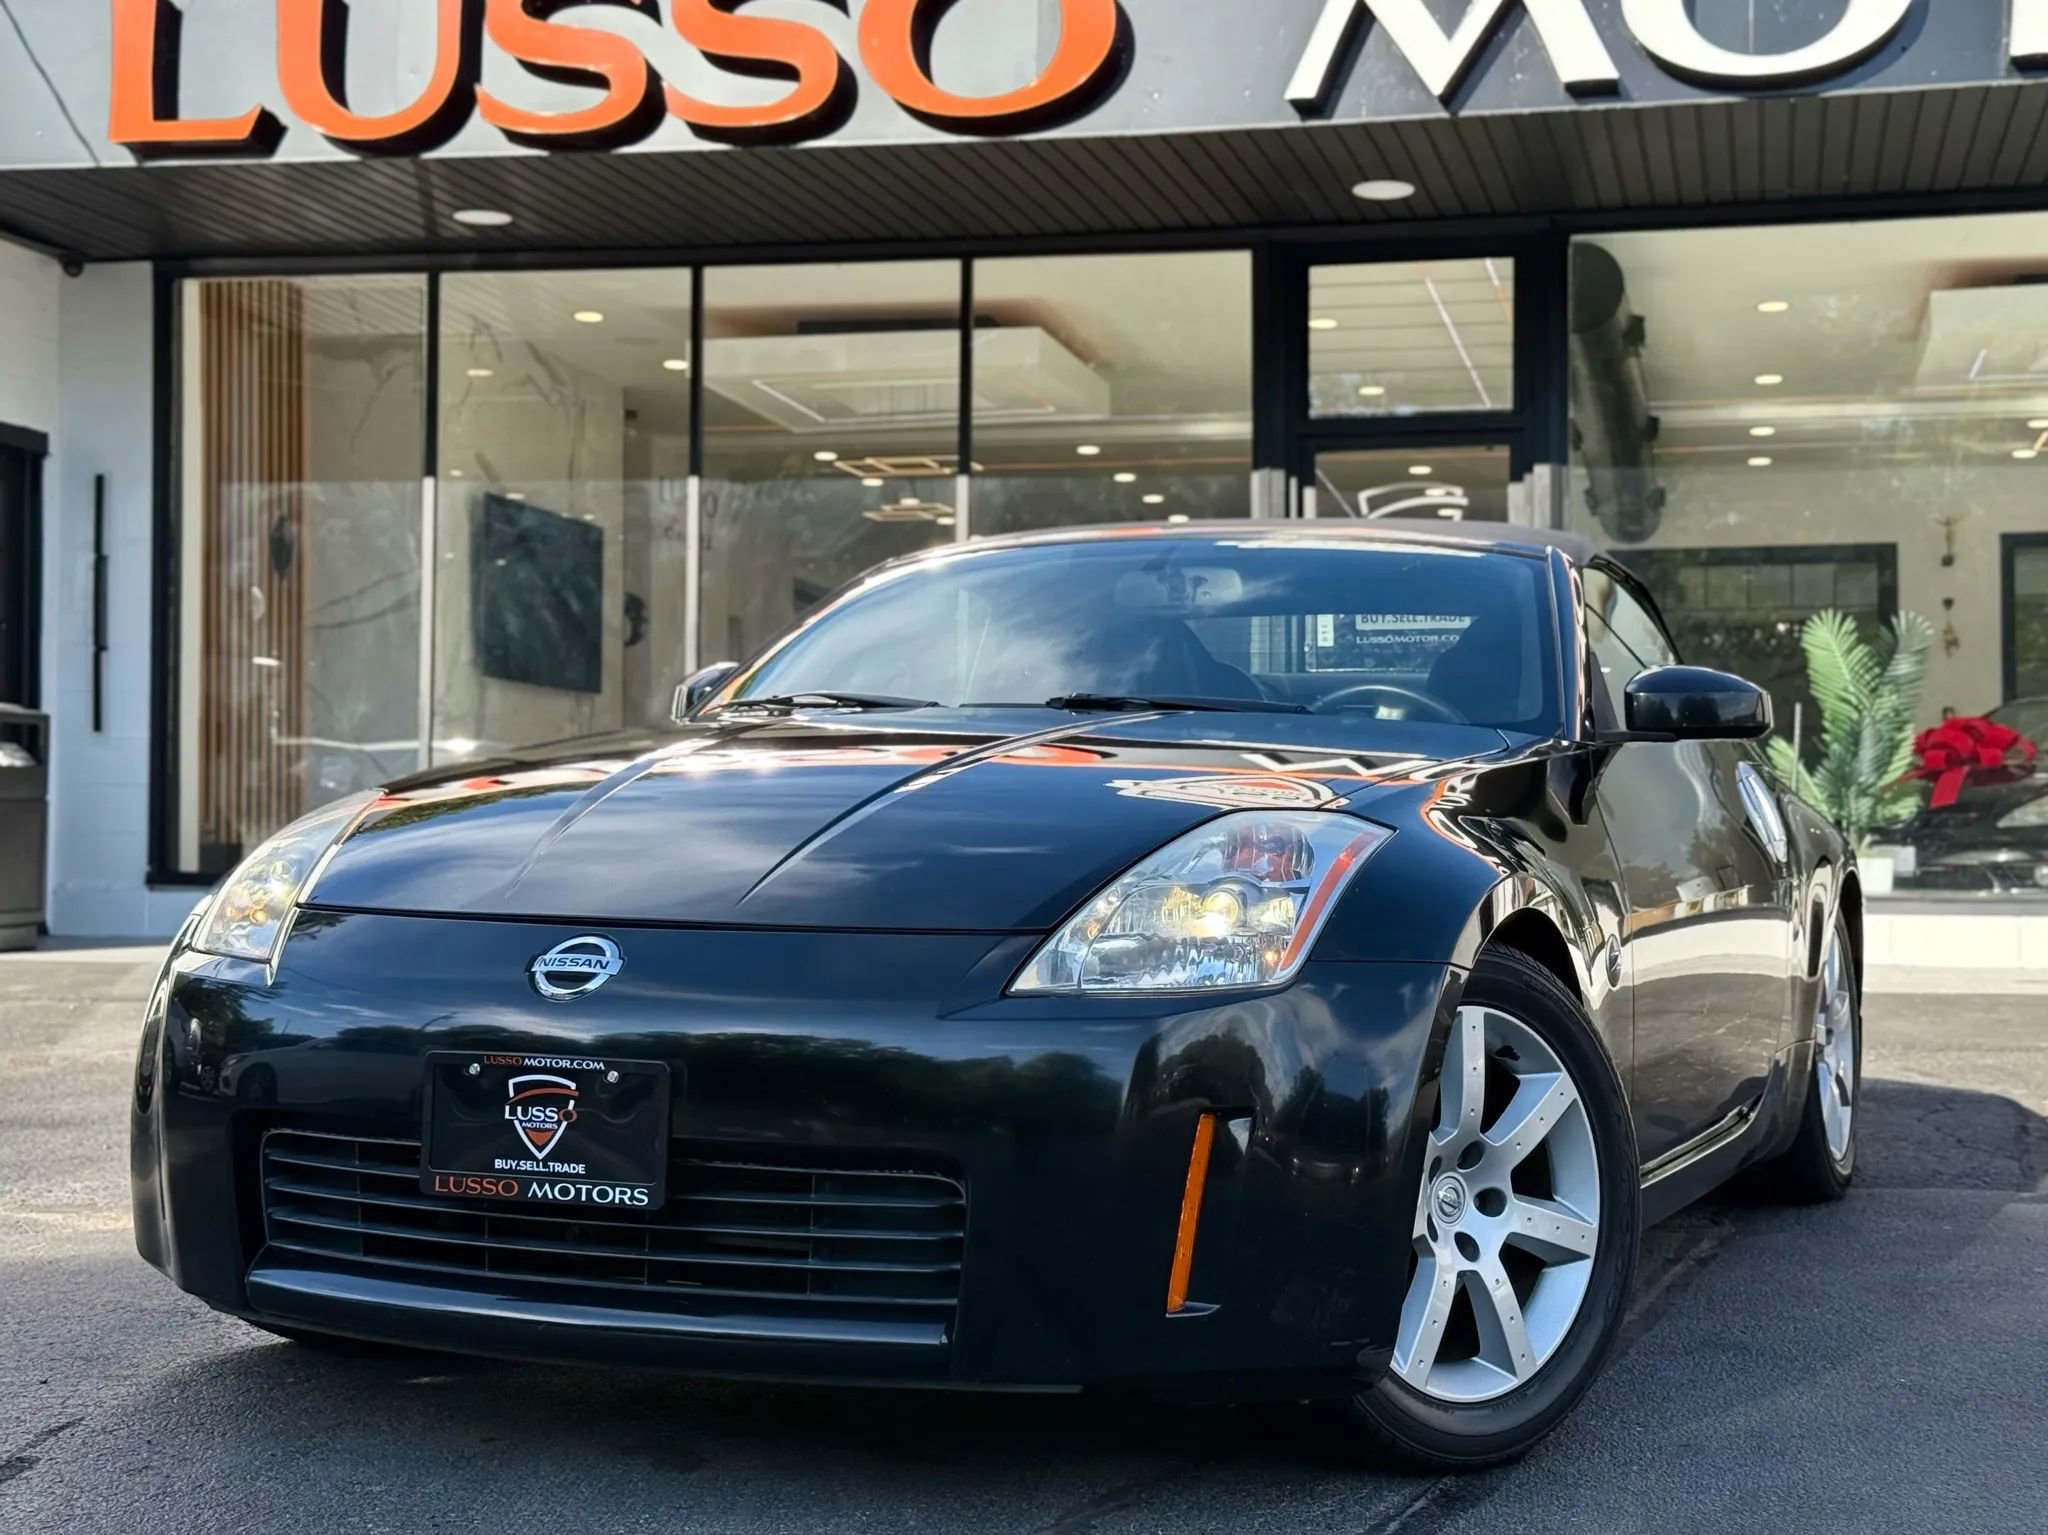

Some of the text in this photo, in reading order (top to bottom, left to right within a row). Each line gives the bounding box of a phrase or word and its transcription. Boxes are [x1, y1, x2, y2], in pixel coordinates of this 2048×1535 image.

[108, 0, 1118, 144] LUSSO
[539, 957, 610, 970] NISSAN
[504, 1105, 578, 1123] LUSSO
[521, 1121, 558, 1130] MOTORS
[494, 1158, 587, 1175] BUY.SELL.TRADE
[434, 1175, 650, 1206] LUSSO MOTORS
